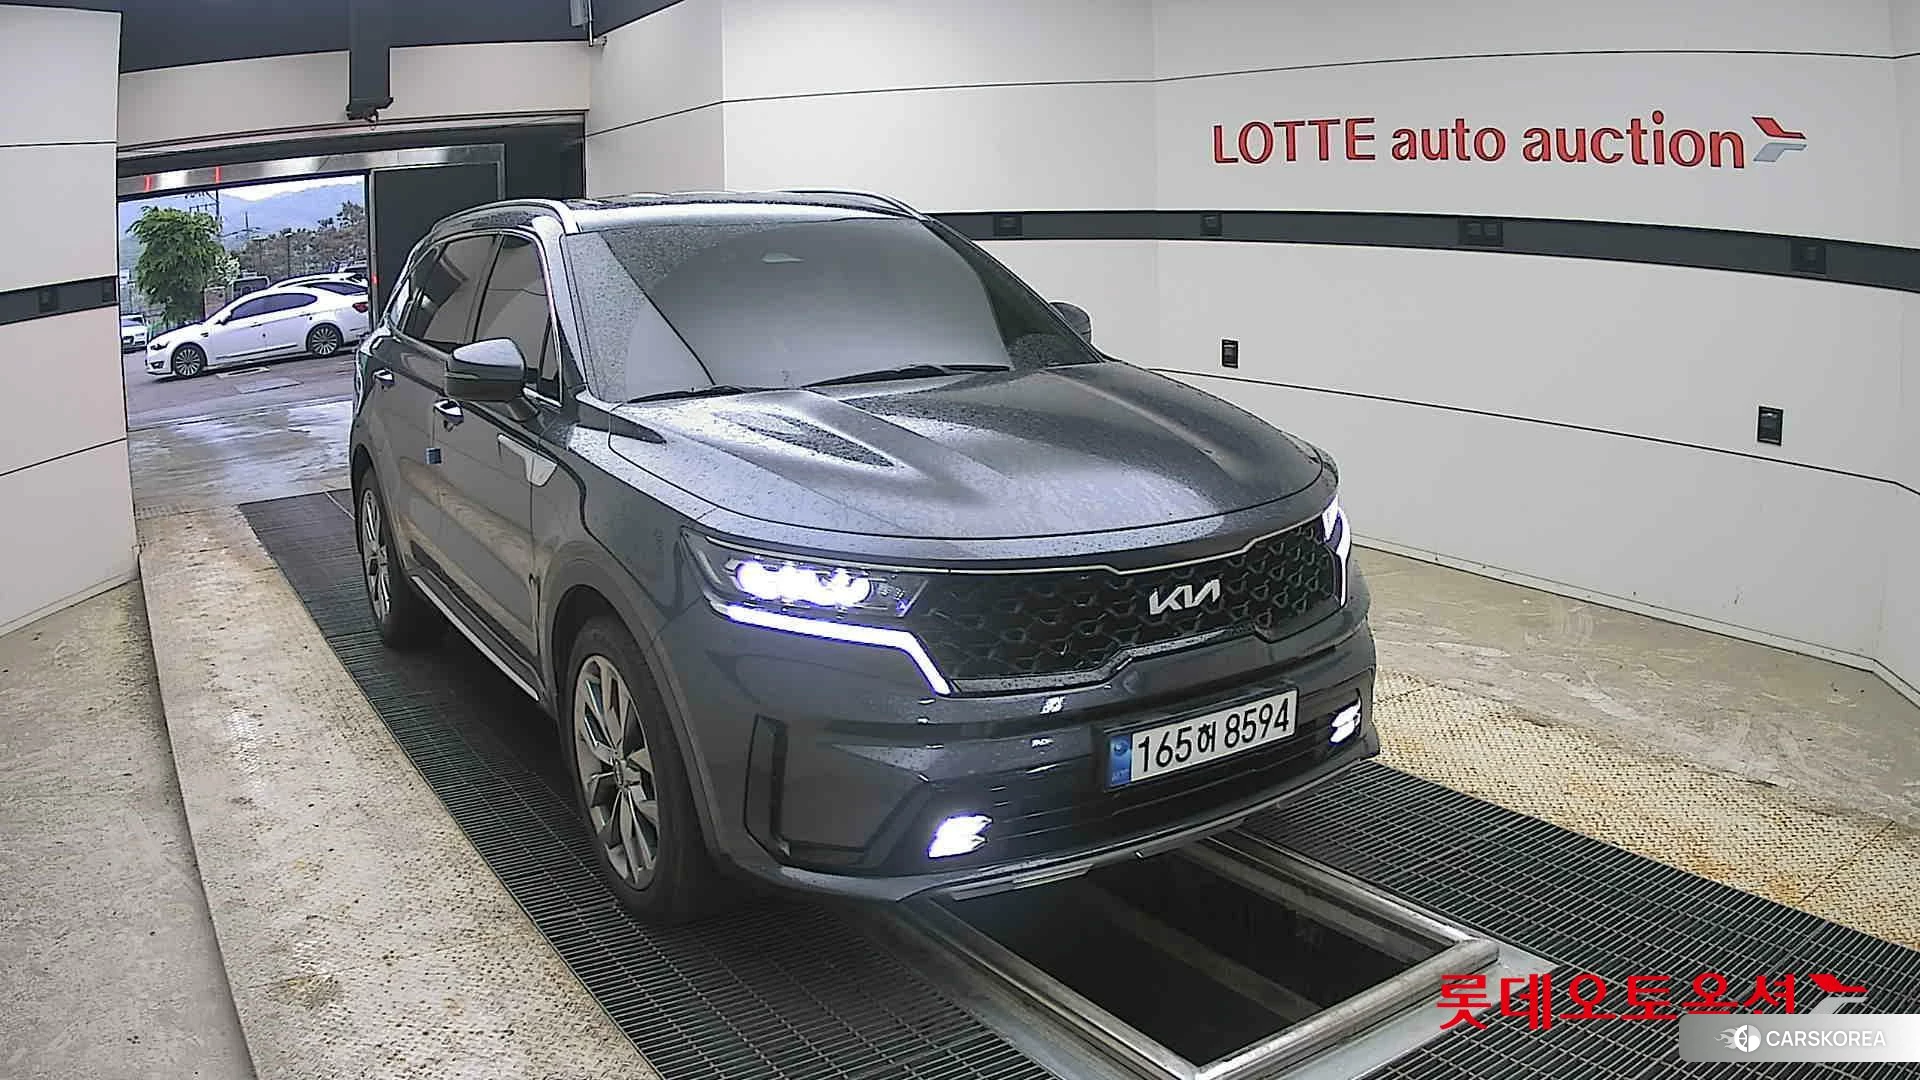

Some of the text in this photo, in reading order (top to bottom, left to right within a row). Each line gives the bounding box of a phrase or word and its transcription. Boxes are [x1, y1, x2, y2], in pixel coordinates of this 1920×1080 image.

[1212, 110, 1745, 168] LOTTE auto auction
[1149, 578, 1220, 616] KIA
[1138, 697, 1289, 772] 165허 8594
